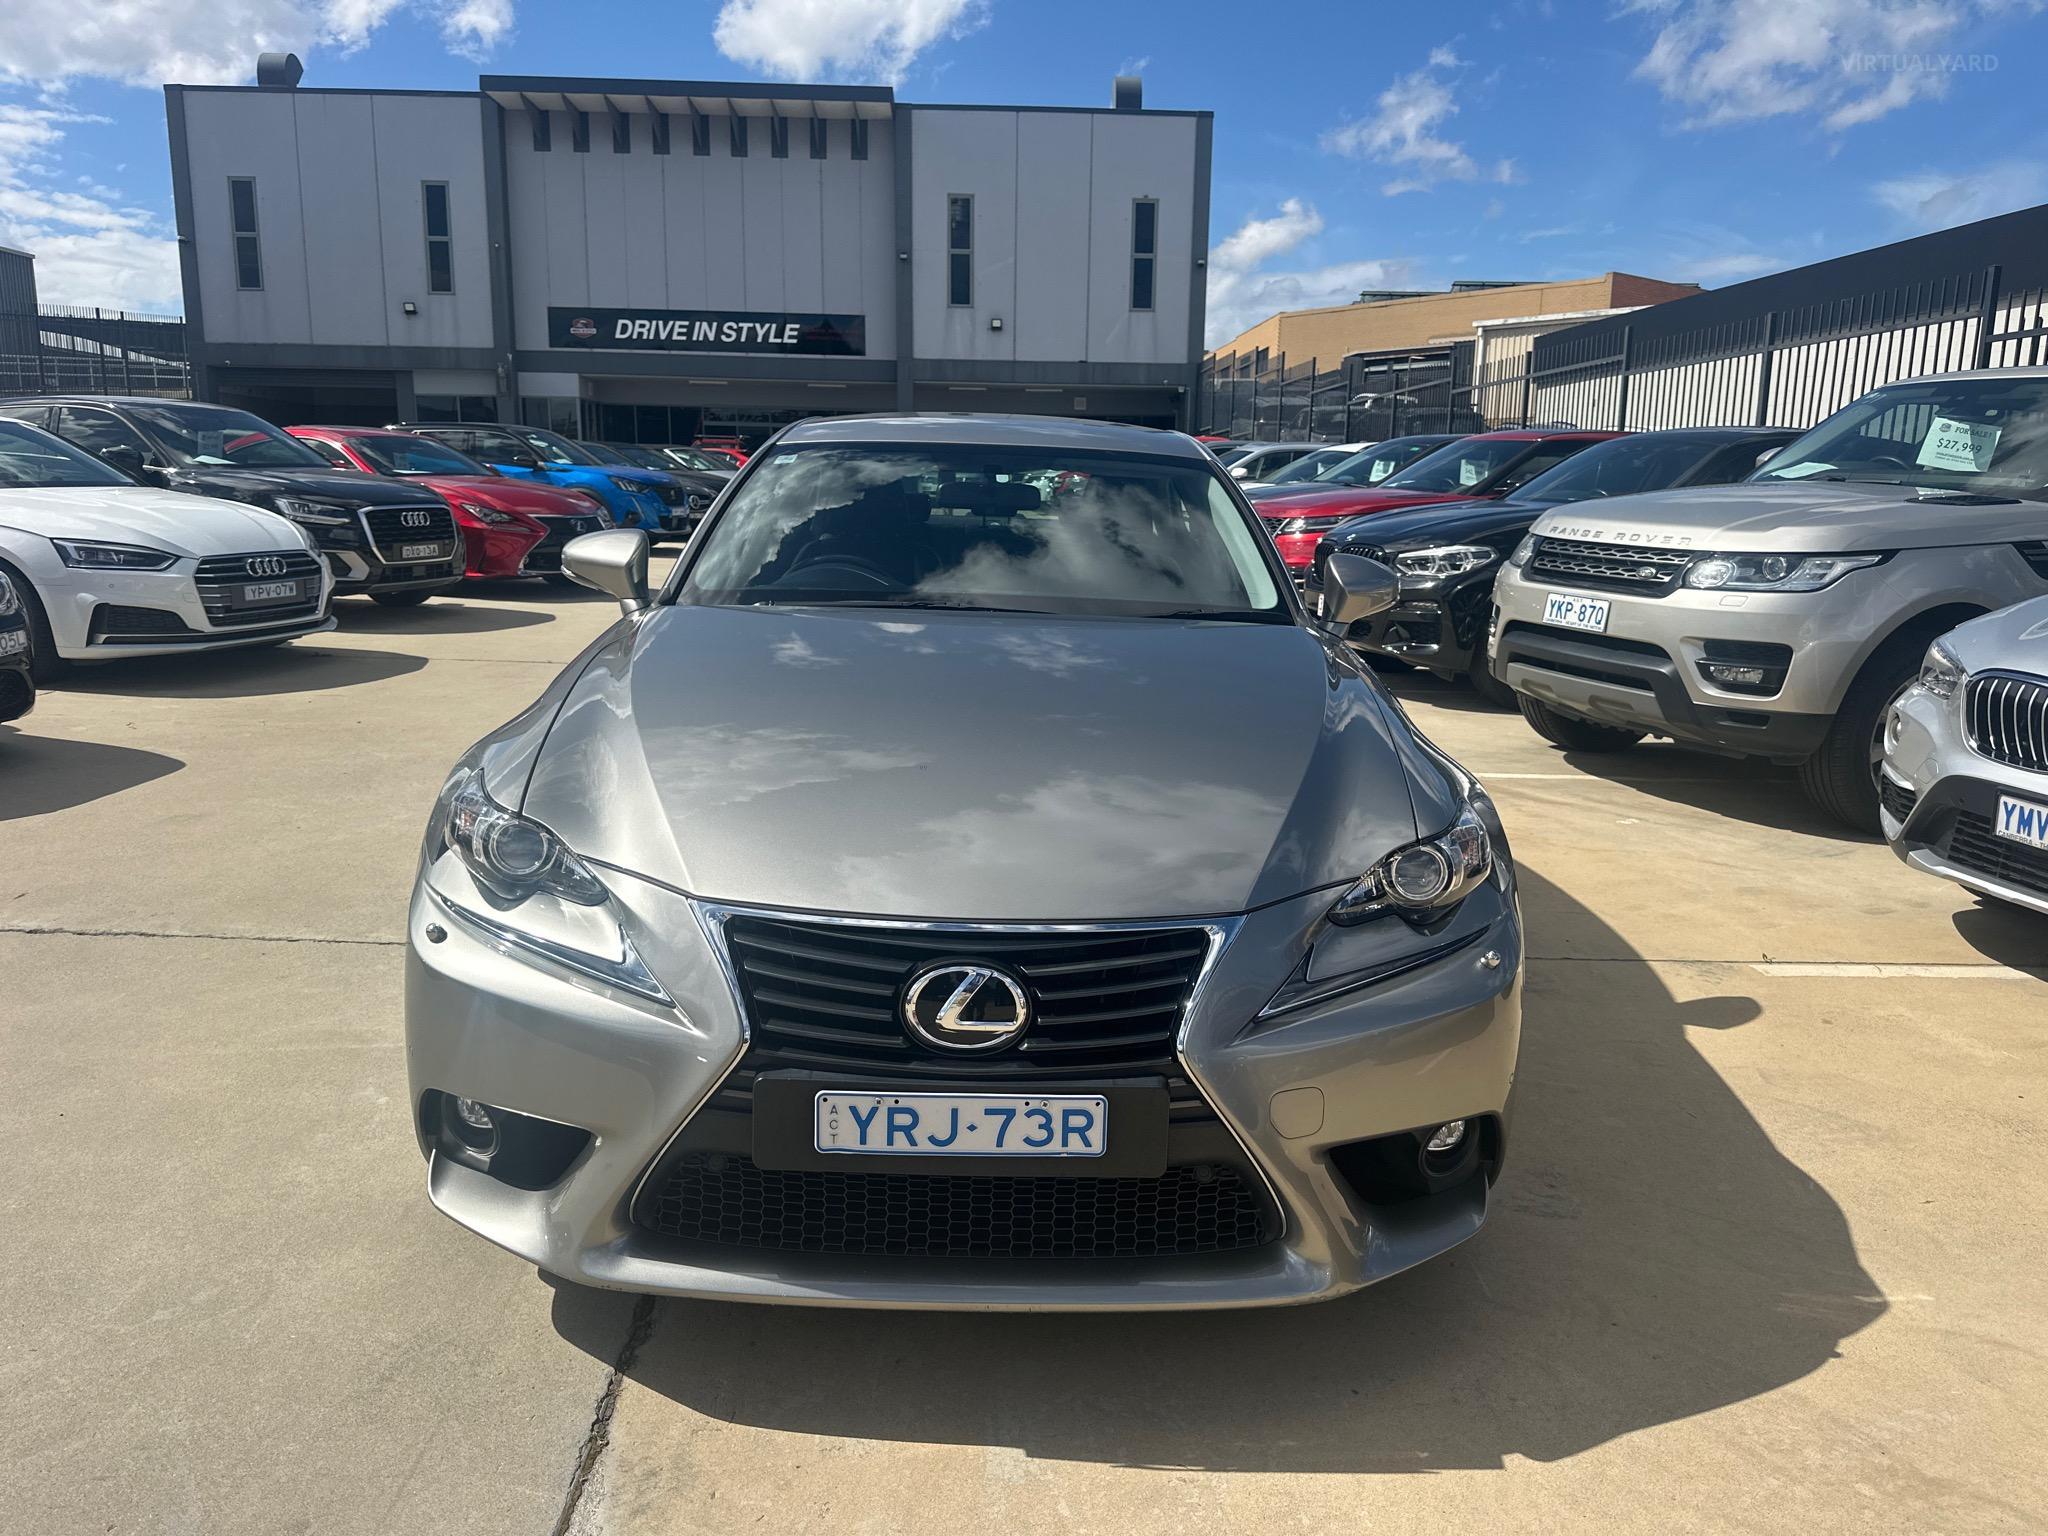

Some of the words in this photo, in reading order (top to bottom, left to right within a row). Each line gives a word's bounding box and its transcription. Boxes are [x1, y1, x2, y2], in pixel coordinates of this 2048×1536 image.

[614, 319, 689, 341] DRIVE
[692, 321, 718, 341] IN
[720, 321, 800, 344] STYLE
[1954, 426, 1970, 435] FOR
[1936, 437, 1983, 454] $27,999
[1549, 526, 1604, 539] RANGE
[1613, 532, 1693, 547] ROVER
[2003, 800, 2048, 842] YMV
